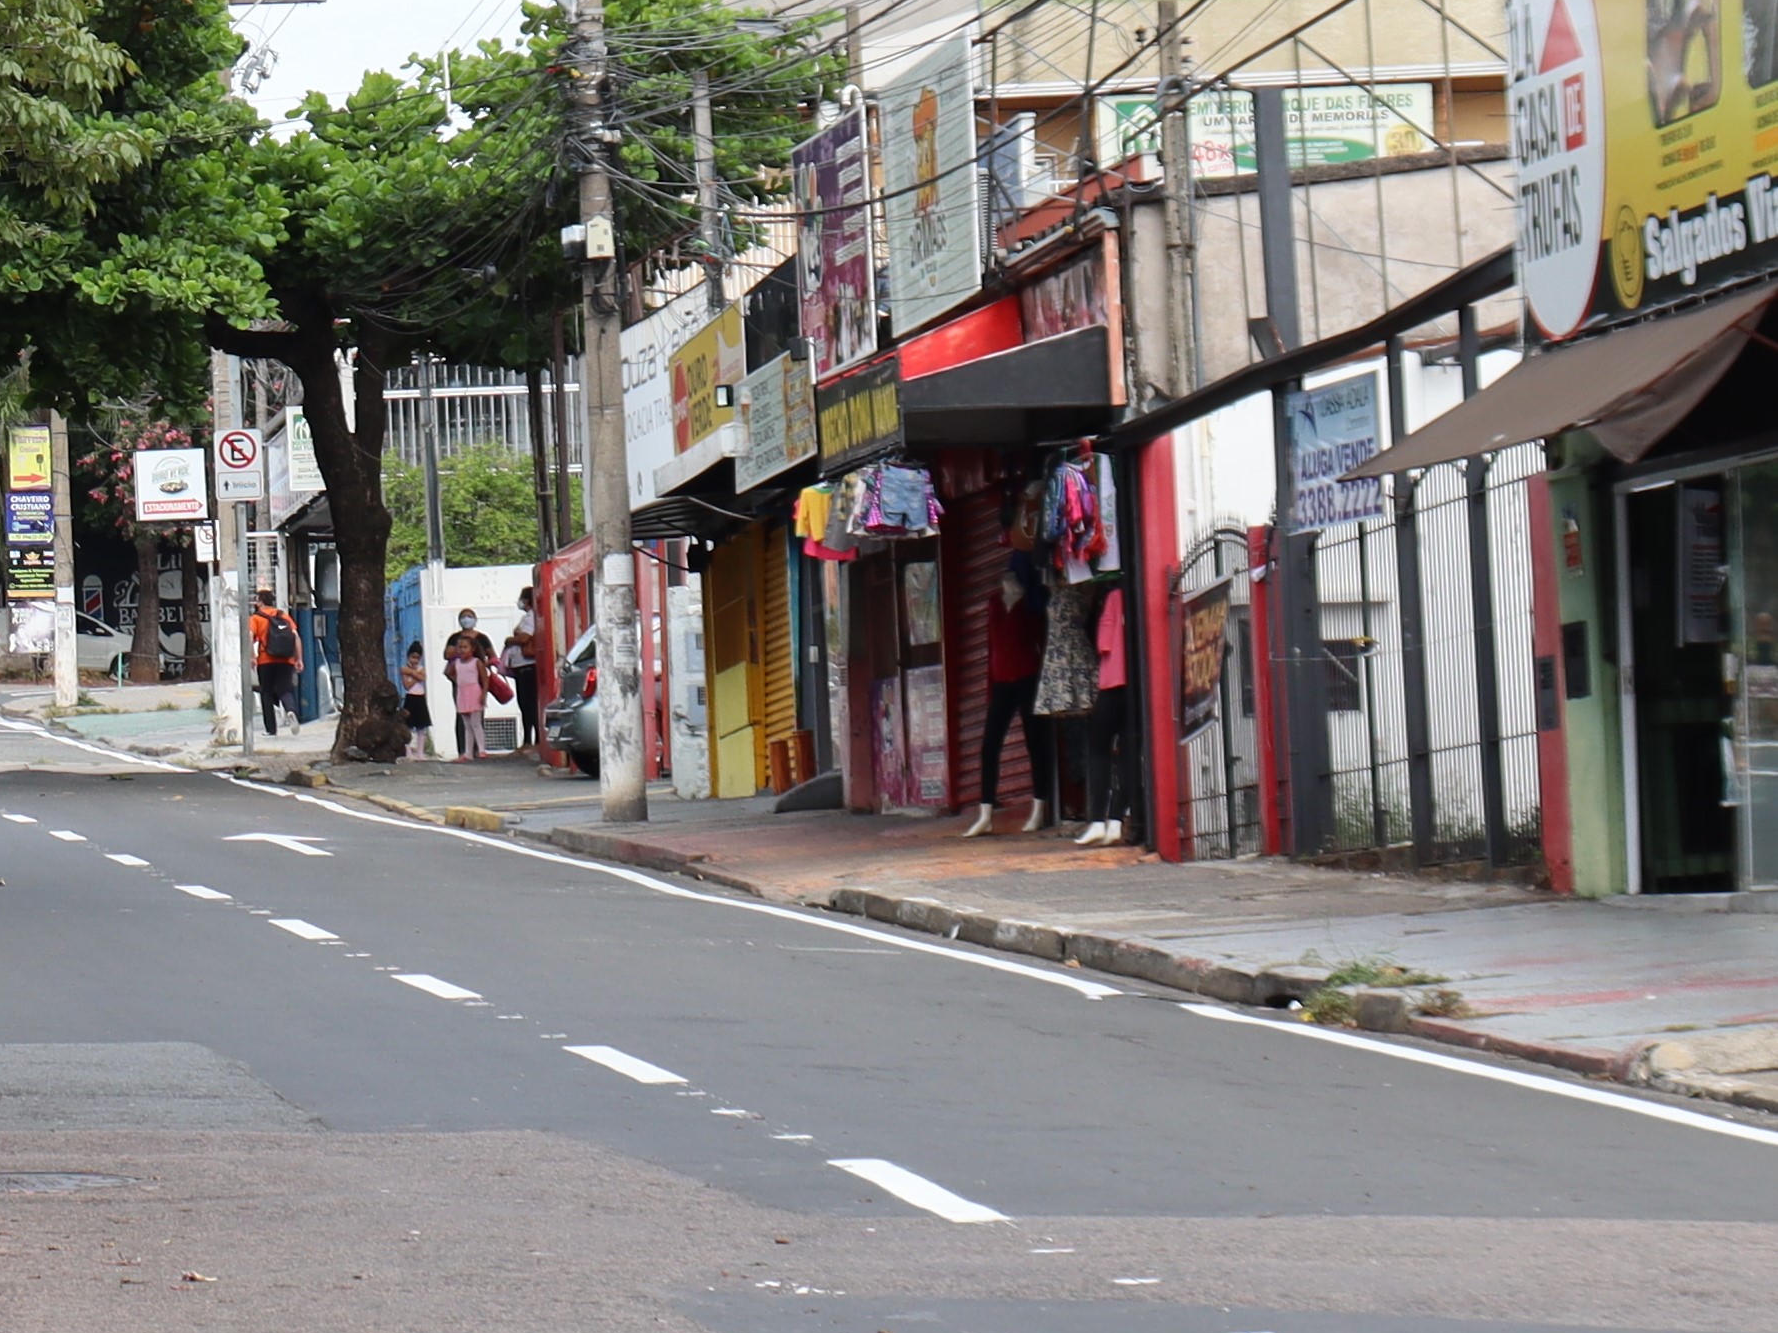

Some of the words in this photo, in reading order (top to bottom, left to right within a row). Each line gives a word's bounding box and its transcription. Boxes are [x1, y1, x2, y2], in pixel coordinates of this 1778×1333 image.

[1516, 83, 1562, 167] CASA
[1565, 77, 1584, 137] DE
[1522, 165, 1583, 264] TRUFAS
[1644, 193, 1746, 285] Salgados
[1301, 447, 1334, 481] ALUGA
[1335, 437, 1375, 473] VENDE
